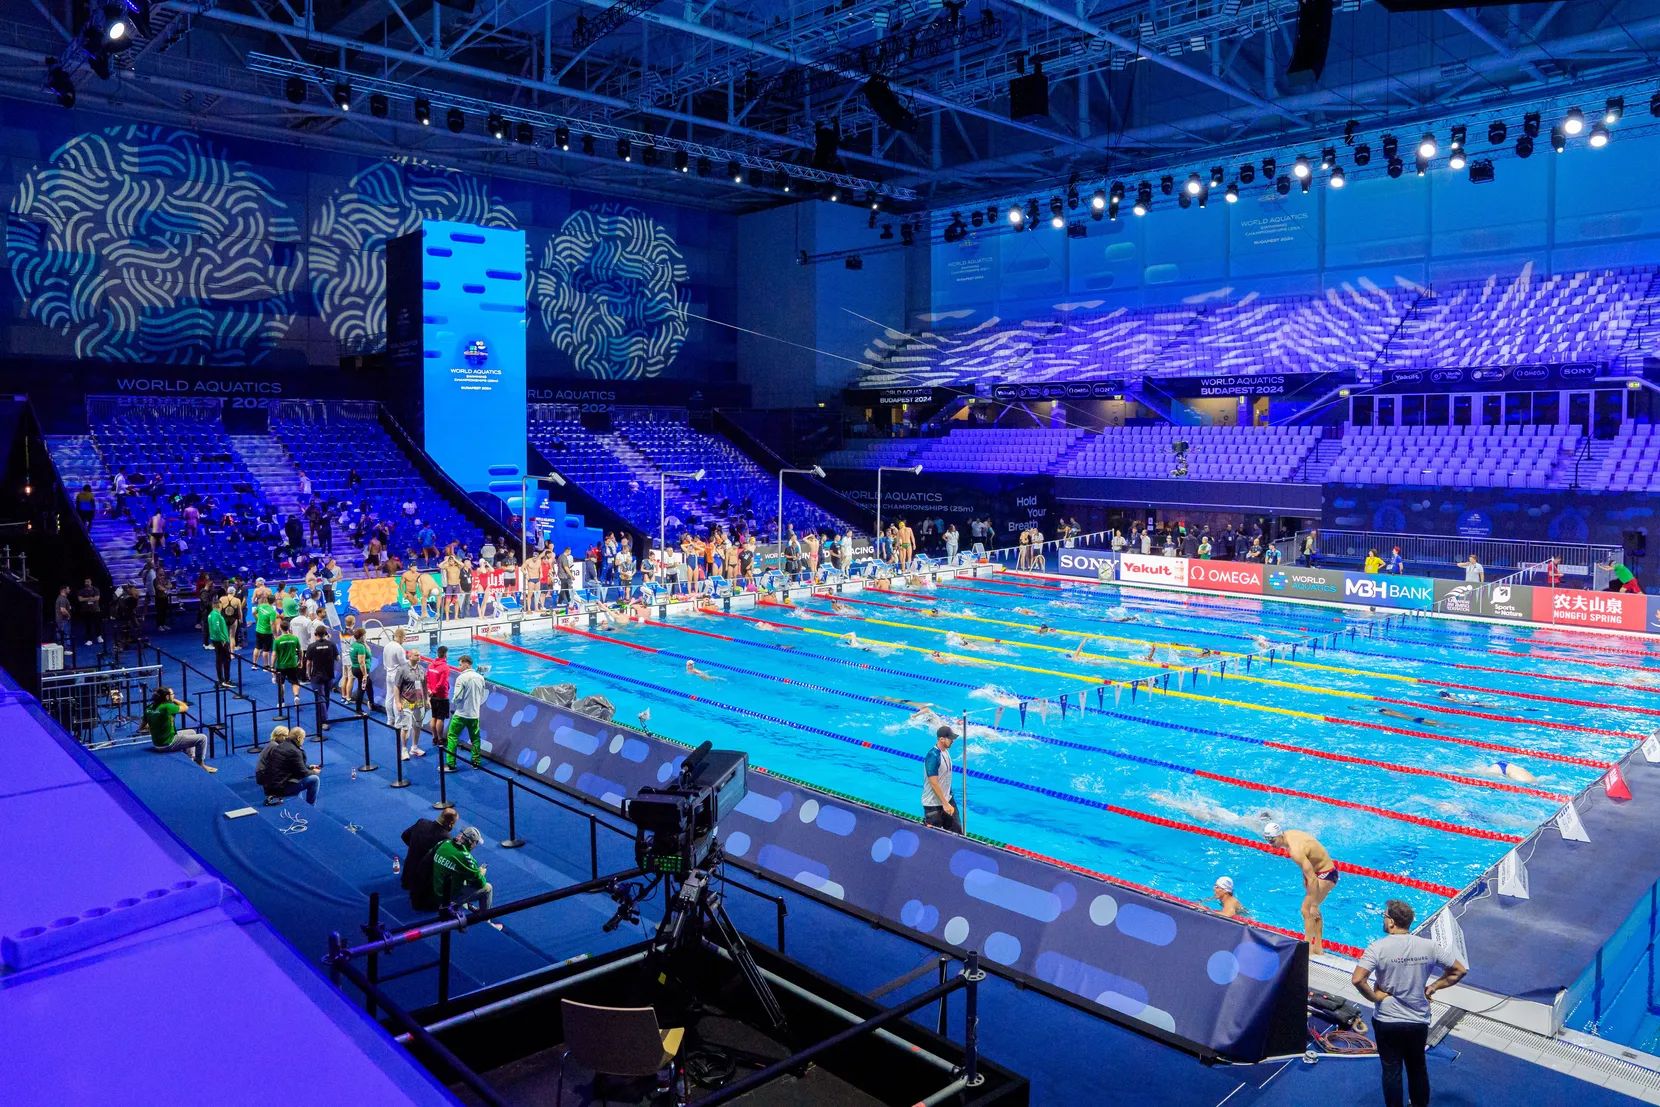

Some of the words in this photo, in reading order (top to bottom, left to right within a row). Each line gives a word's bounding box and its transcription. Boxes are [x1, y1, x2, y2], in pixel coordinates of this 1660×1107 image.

[117, 379, 189, 391] WORLD
[193, 380, 282, 394] AQUATICS
[1200, 377, 1235, 386] WORLD
[1236, 376, 1285, 385] AQUATICS
[527, 389, 553, 399] RLD
[555, 390, 616, 401] AQUATICS
[1200, 387, 1254, 395] BUDAPEST
[1255, 386, 1284, 394] 2024
[841, 490, 881, 500] WORLD
[884, 492, 943, 502] AQUATICS
[1016, 496, 1037, 507] Hold
[882, 503, 949, 512] CHAMPIONSHIPS
[950, 504, 974, 513] (25m)
[1027, 508, 1047, 518] Your
[1008, 520, 1039, 531] Breath
[850, 546, 875, 556] ACING
[1060, 555, 1119, 571] SONY
[1124, 562, 1173, 576] Yakult
[1208, 570, 1260, 586] OMEGA
[1292, 575, 1326, 584] WORLD
[1292, 583, 1337, 593] AQUATICS
[1345, 578, 1387, 599] MBH
[1389, 584, 1433, 600] BANK
[1554, 593, 1623, 614] 农夫山泉
[1553, 610, 1587, 620] NONGFU
[1590, 613, 1623, 624] SPRING
